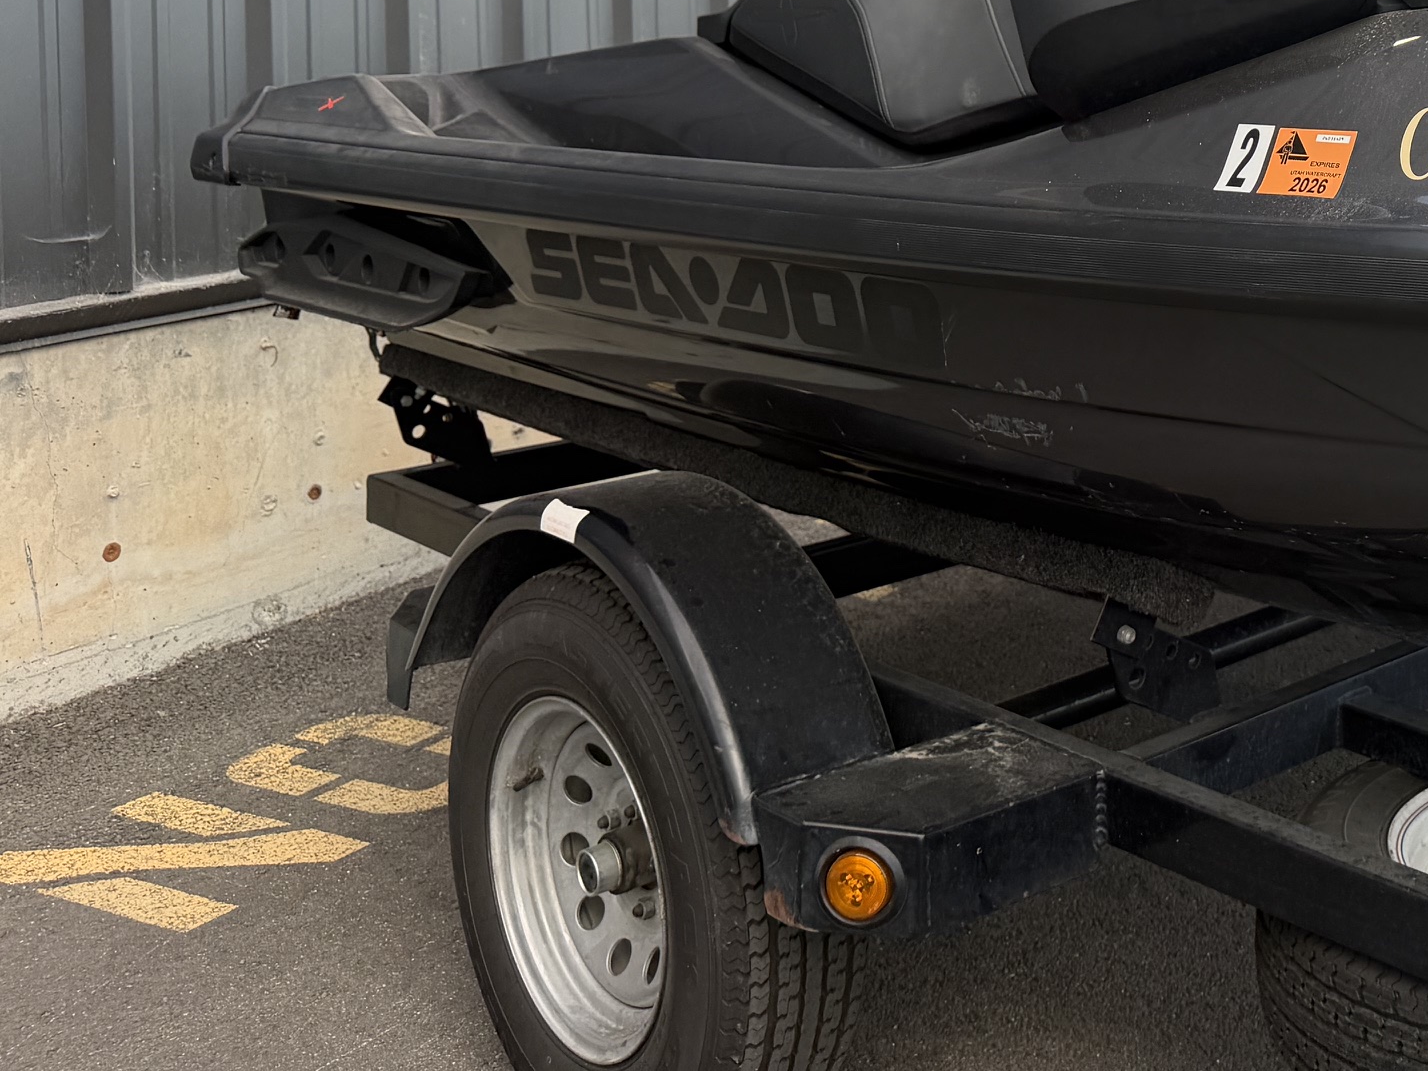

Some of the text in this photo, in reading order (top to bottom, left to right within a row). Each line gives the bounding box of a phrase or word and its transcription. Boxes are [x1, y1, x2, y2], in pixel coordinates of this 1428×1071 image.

[1226, 128, 1260, 188] 2
[1310, 161, 1341, 169] EXPIRES
[1305, 171, 1342, 179] WATERCRAFT
[1288, 177, 1329, 194] 2026
